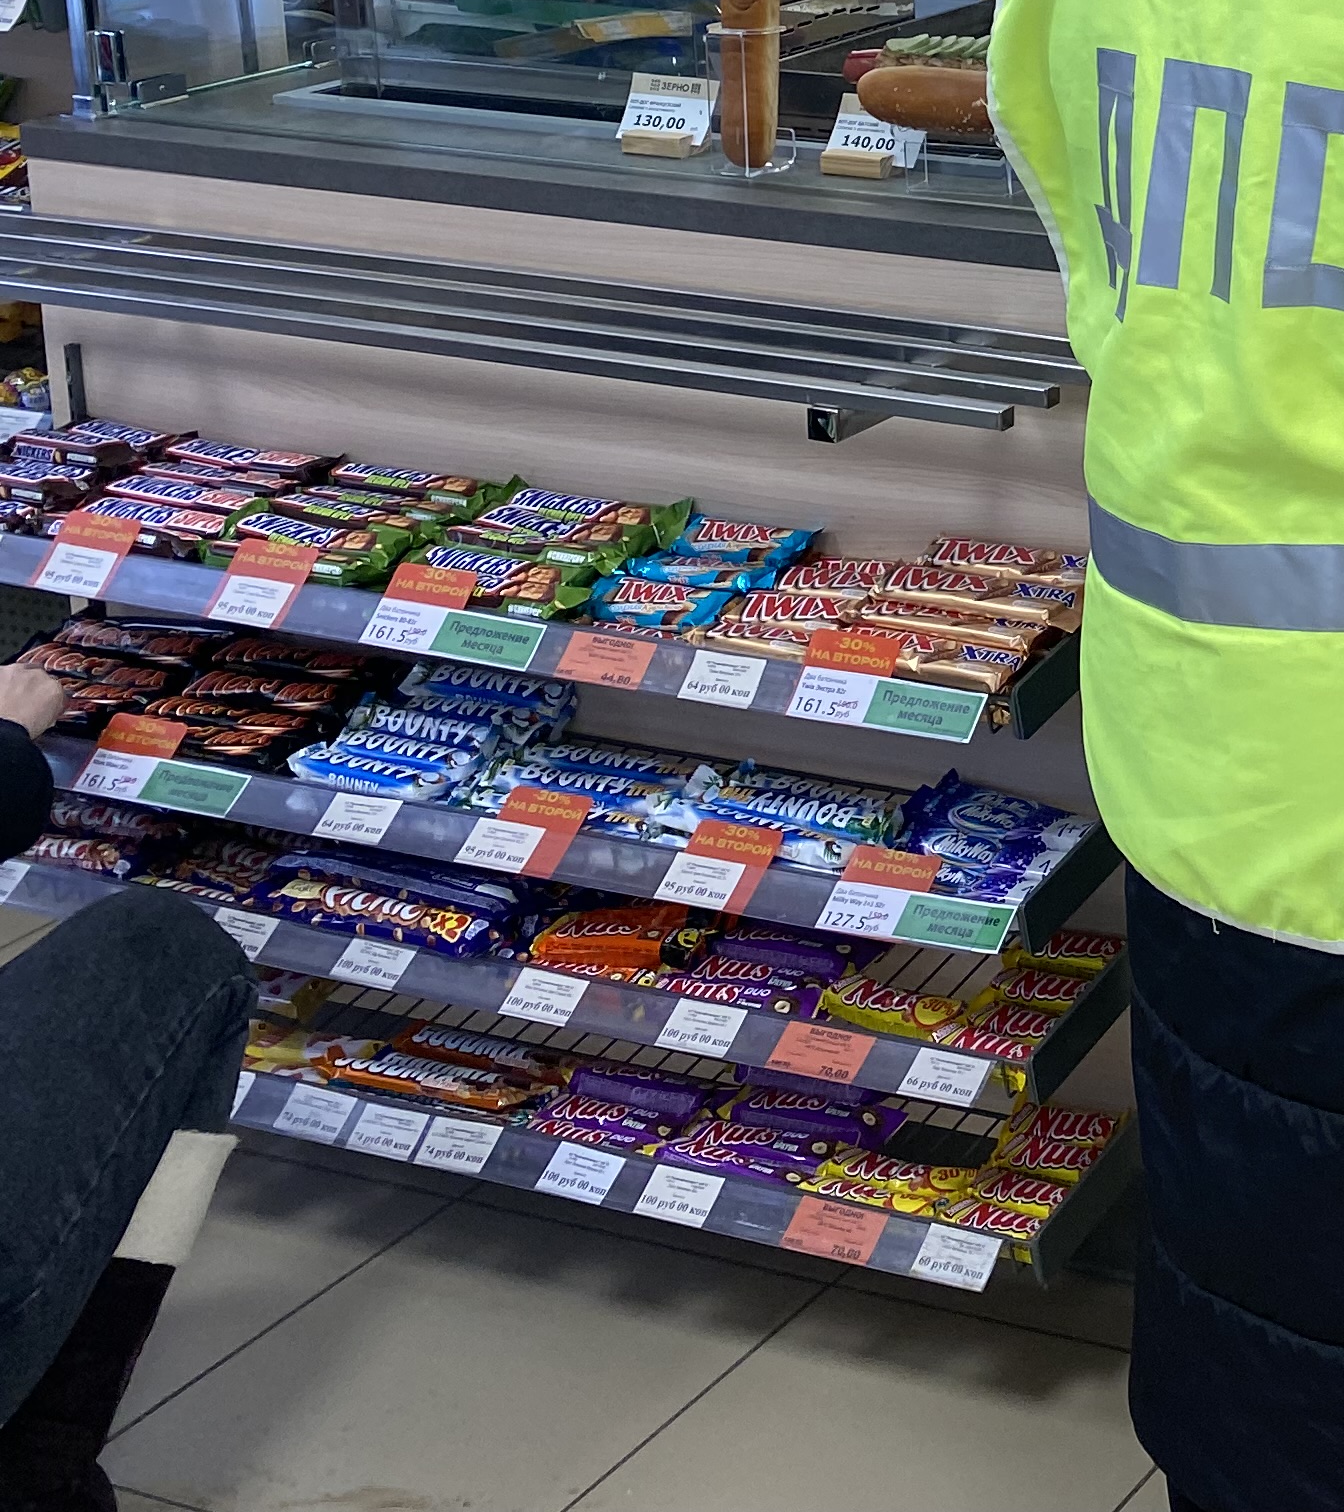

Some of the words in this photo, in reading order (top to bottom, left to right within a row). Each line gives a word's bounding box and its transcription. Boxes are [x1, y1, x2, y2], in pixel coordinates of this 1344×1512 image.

[661, 82, 690, 93] ЗЕРНО
[633, 115, 685, 130] 130,00
[841, 135, 895, 151] 140,00
[698, 518, 776, 544] TWIX
[936, 538, 1037, 565] TWIX
[1015, 583, 1076, 608] XTRA
[835, 636, 876, 653] -30%
[811, 648, 829, 661] НА
[833, 649, 891, 669] ВТОРОЙ
[794, 695, 837, 717] 161.5
[883, 689, 971, 715] Предложение
[371, 706, 478, 742] BOUNTY
[898, 708, 943, 726] месяца
[823, 909, 866, 929] 127.5
[701, 956, 772, 982] Nuts
